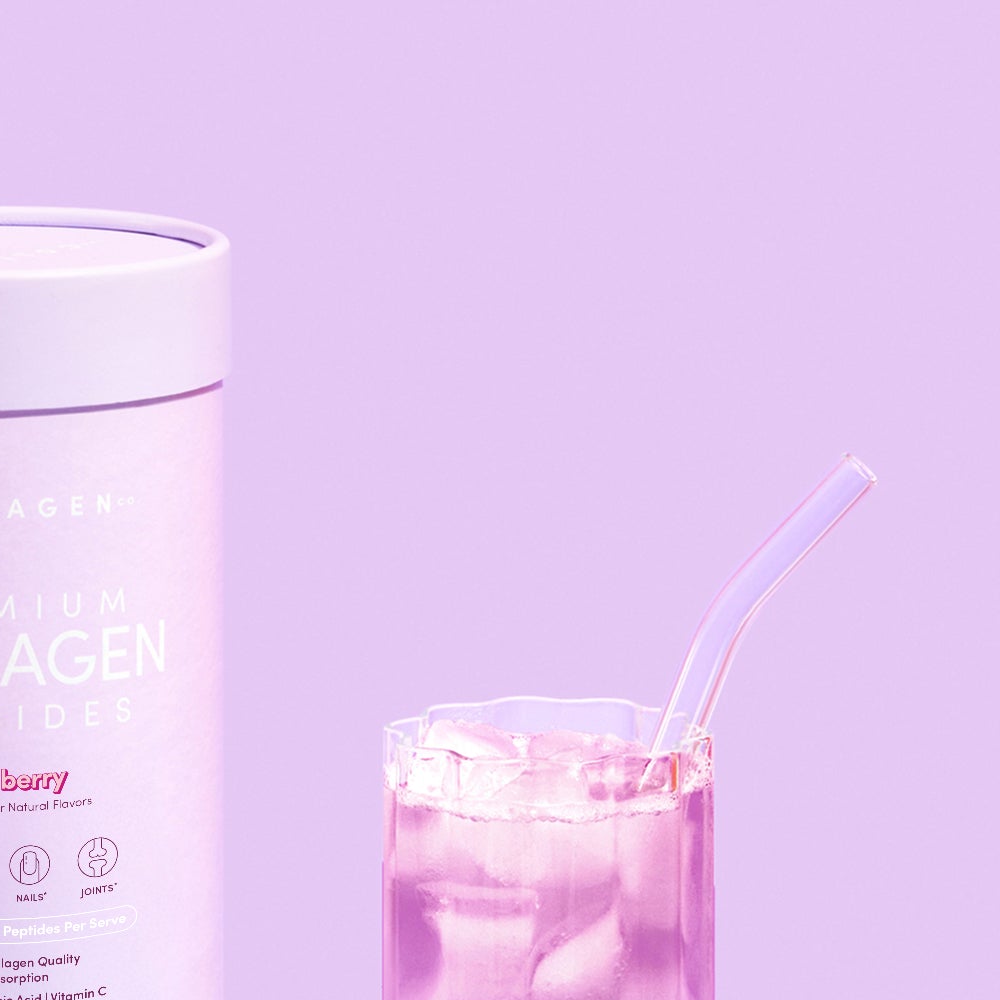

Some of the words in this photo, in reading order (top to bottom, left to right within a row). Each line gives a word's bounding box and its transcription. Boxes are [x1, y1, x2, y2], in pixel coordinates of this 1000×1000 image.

[0, 768, 69, 794] berry
[8, 800, 49, 812] Natural
[53, 796, 92, 810] Flavors
[3, 923, 60, 940] Peptides
[64, 919, 86, 934] Per
[89, 913, 127, 929] Serve
[37, 953, 81, 967] Quality
[97, 986, 107, 997] C
